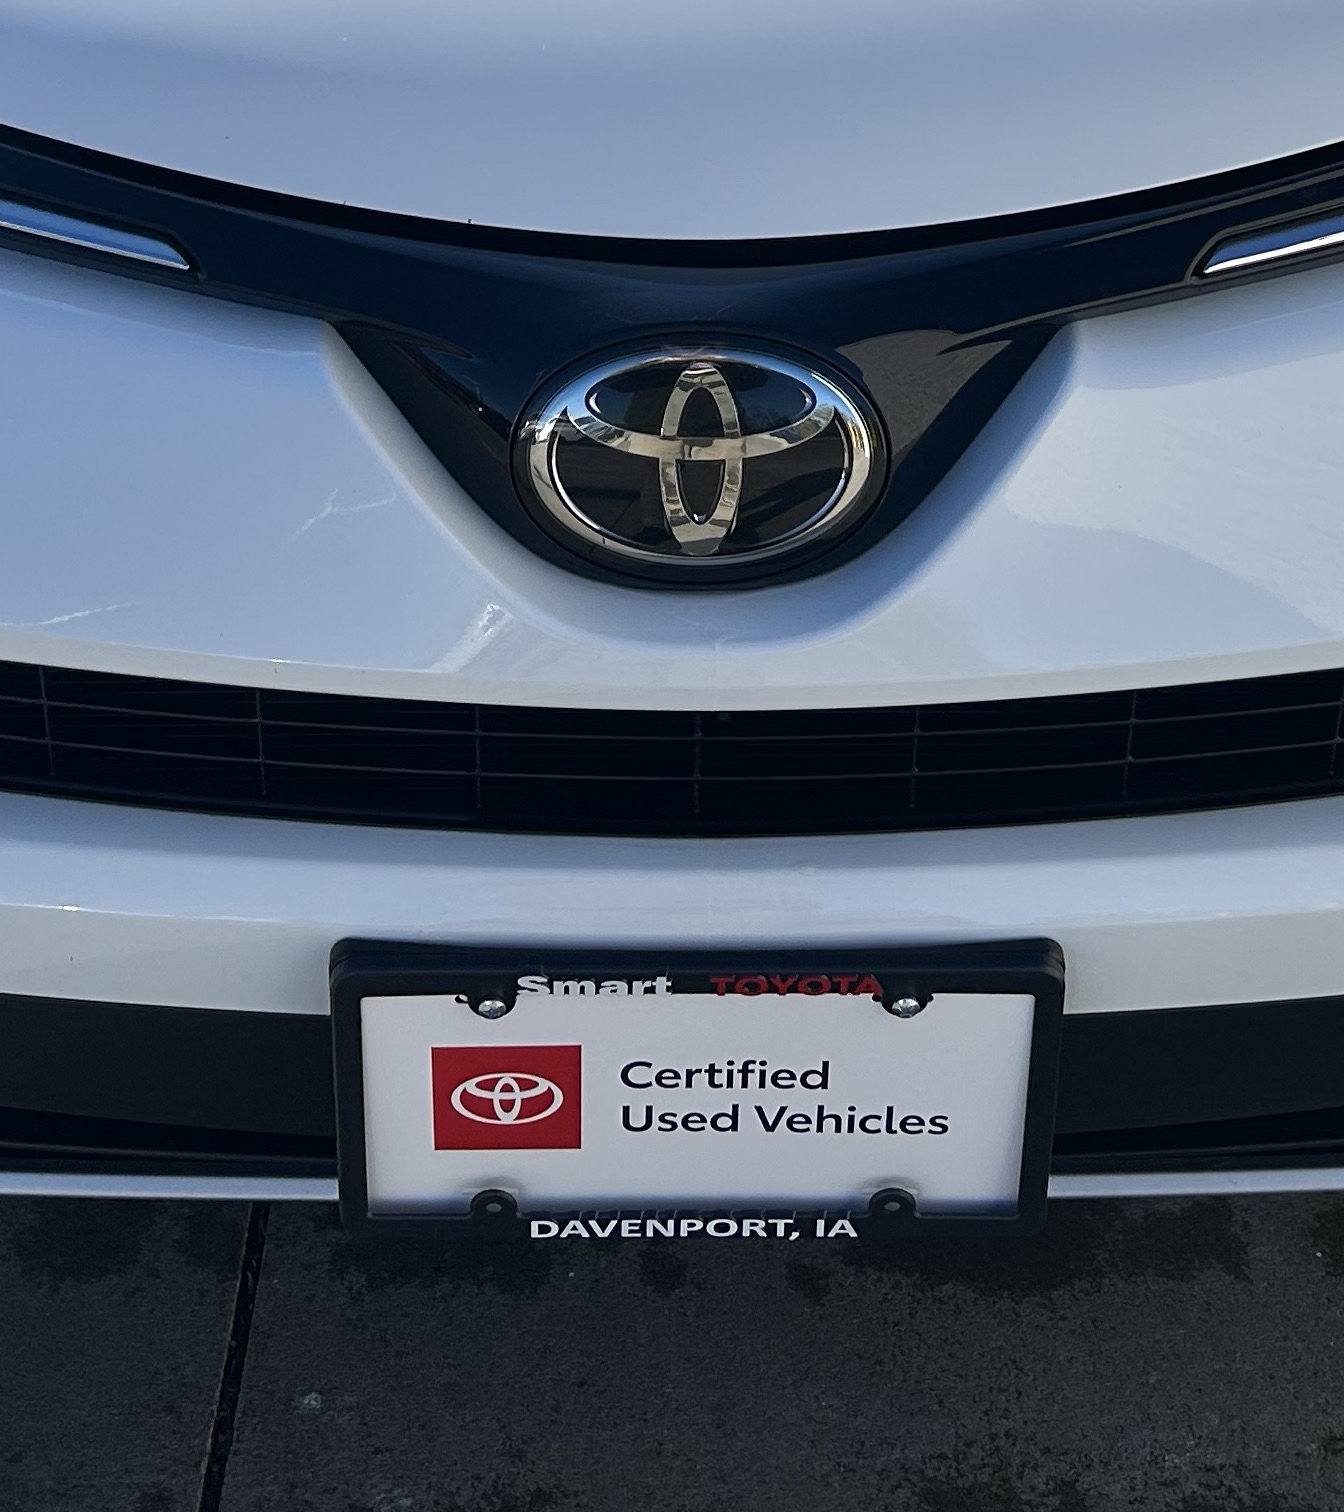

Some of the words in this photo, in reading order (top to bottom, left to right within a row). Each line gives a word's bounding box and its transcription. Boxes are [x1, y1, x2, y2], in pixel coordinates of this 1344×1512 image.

[517, 975, 673, 997] Smart
[708, 975, 884, 997] TOYOTA
[619, 1060, 831, 1090] Certified
[621, 1104, 741, 1134] Used
[755, 1104, 950, 1136] Vehicles
[531, 1218, 800, 1241] DAVENPORT,
[816, 1218, 858, 1238] IA
